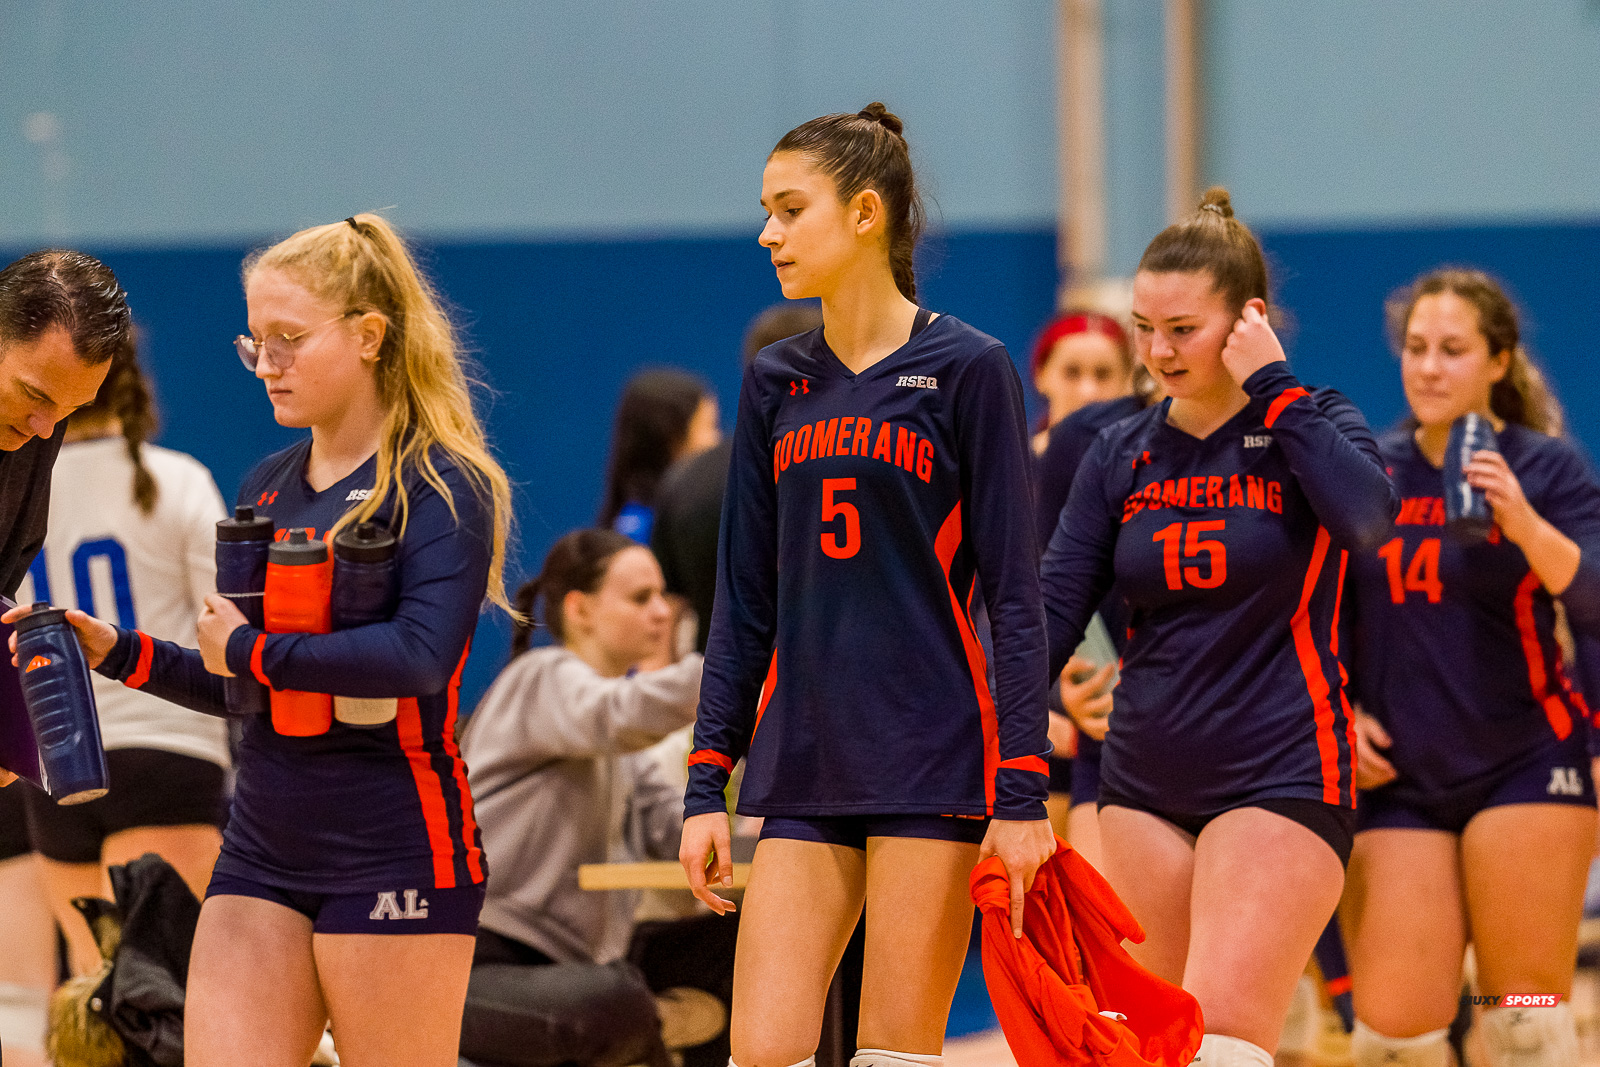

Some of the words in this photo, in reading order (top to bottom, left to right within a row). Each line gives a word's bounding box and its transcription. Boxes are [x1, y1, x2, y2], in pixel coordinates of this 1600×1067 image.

[895, 375, 938, 390] RSEQ
[820, 477, 861, 559] 5
[1152, 519, 1227, 590] 15
[1377, 537, 1443, 604] 14
[369, 889, 428, 920] AL
